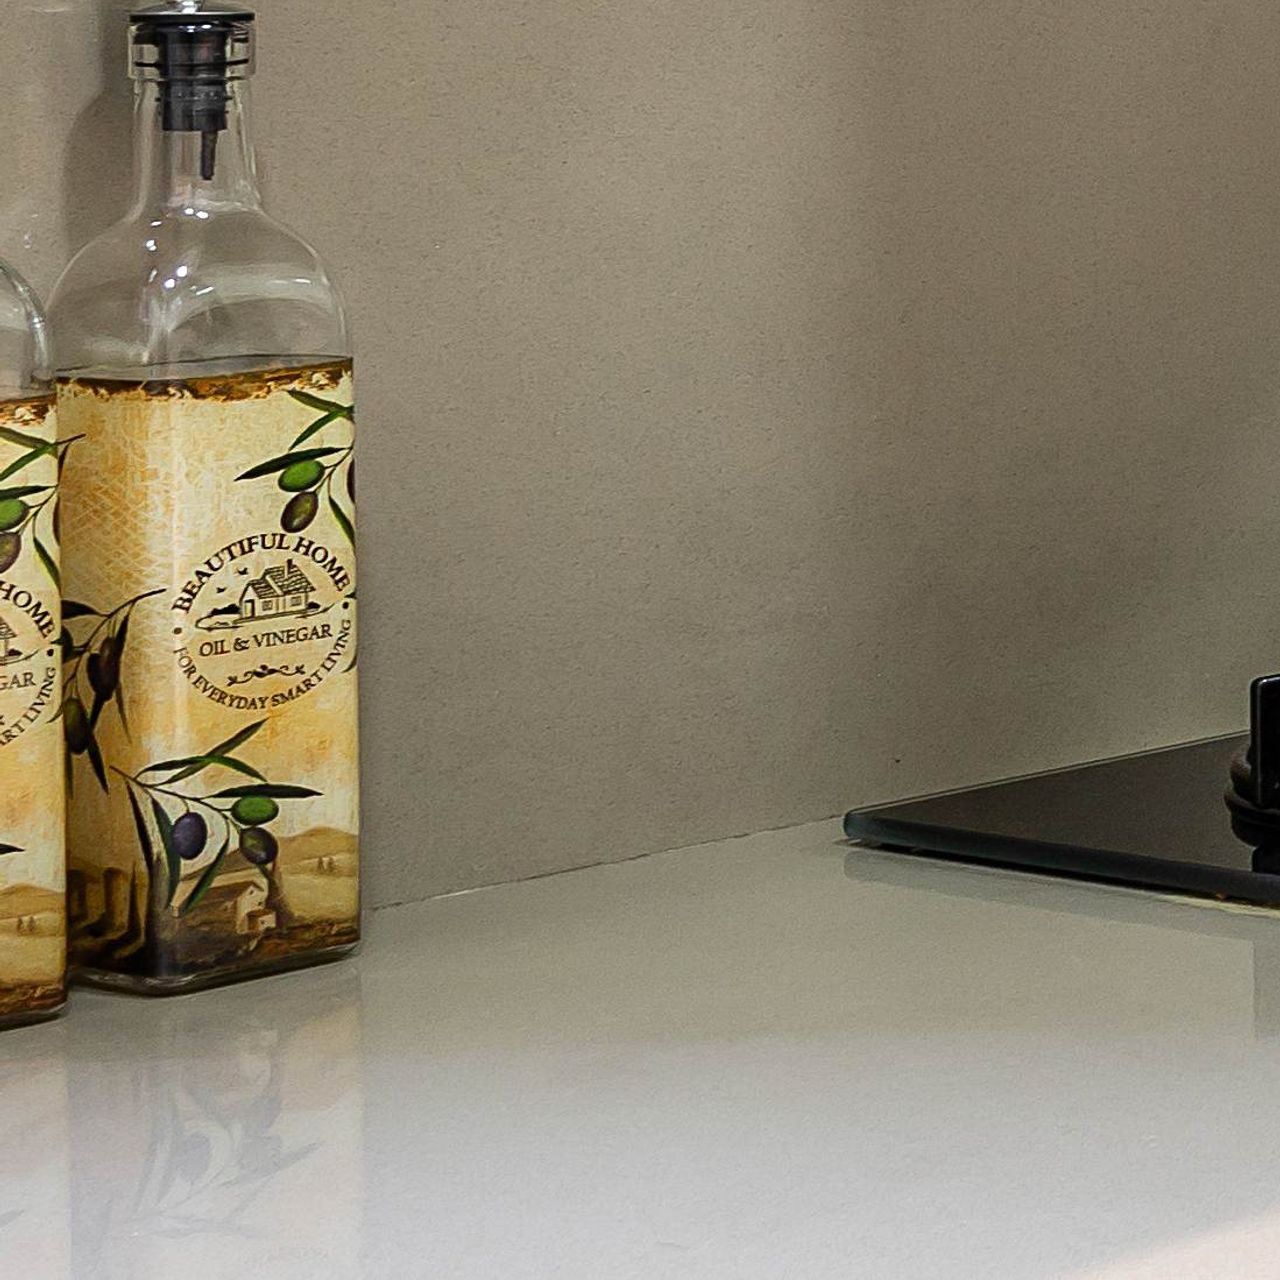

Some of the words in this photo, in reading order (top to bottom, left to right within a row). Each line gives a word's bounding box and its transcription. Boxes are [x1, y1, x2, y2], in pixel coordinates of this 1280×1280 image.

[171, 533, 290, 615] BEAUTIFUL
[293, 535, 350, 592] HOME
[0, 580, 56, 638] HOME
[173, 646, 198, 679] FOR
[192, 675, 269, 711] EVERYDAY
[271, 671, 324, 707] SMART
[321, 619, 351, 671] LIVING
[199, 639, 230, 657] OIL
[233, 637, 250, 651] &
[252, 624, 333, 648] VINEGAR
[23, 667, 56, 722] LIVING
